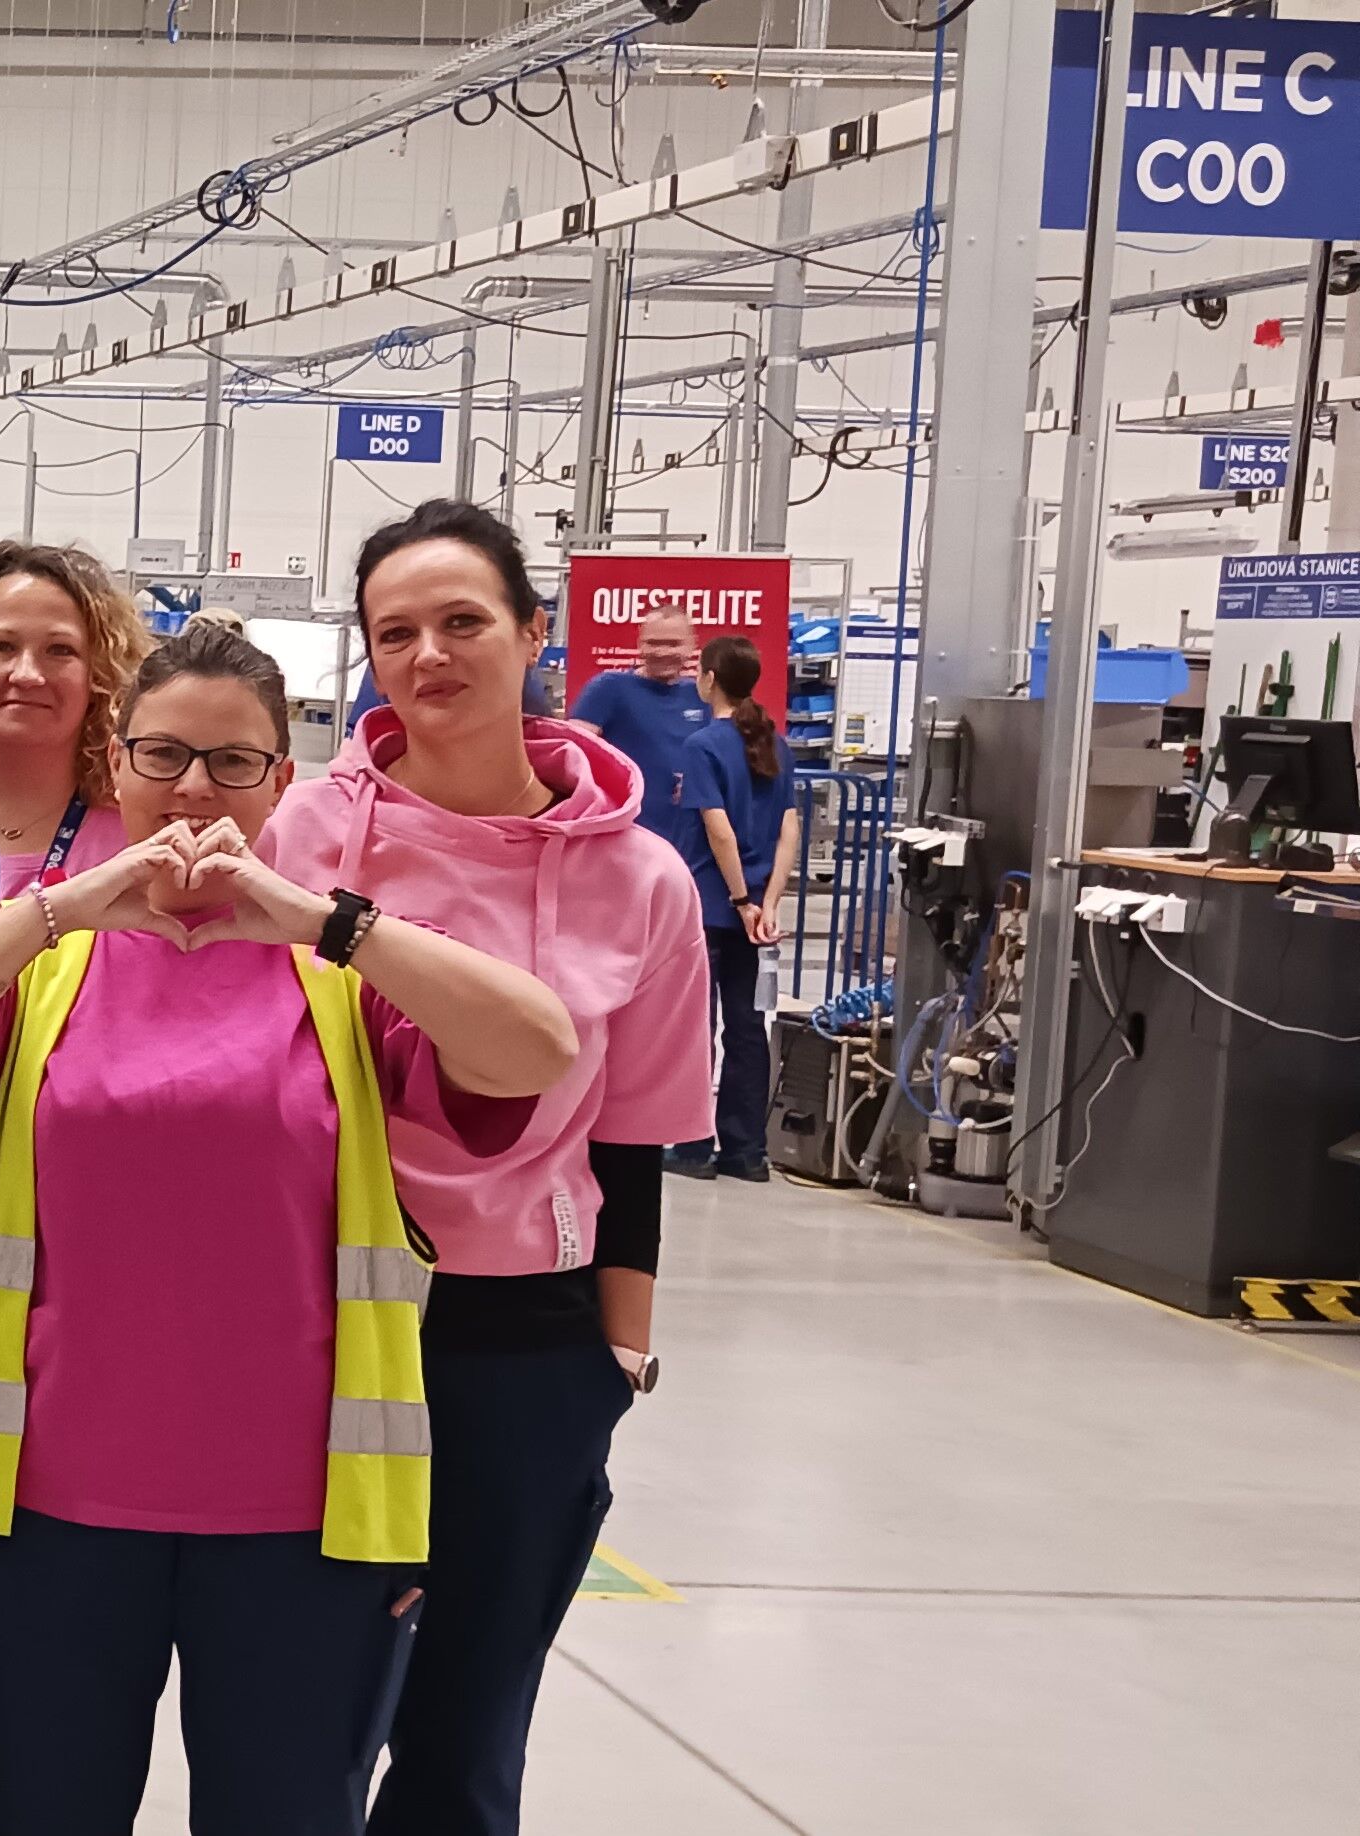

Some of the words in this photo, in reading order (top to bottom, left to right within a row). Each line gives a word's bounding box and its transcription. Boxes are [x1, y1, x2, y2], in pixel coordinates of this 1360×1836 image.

[1284, 51, 1336, 116] C
[1136, 138, 1286, 207] C00
[361, 413, 403, 433] LINE
[406, 415, 421, 433] D
[369, 437, 409, 456] D00
[1214, 443, 1256, 462] LNE
[1228, 466, 1276, 485] S200
[1299, 557, 1360, 577] STANICE
